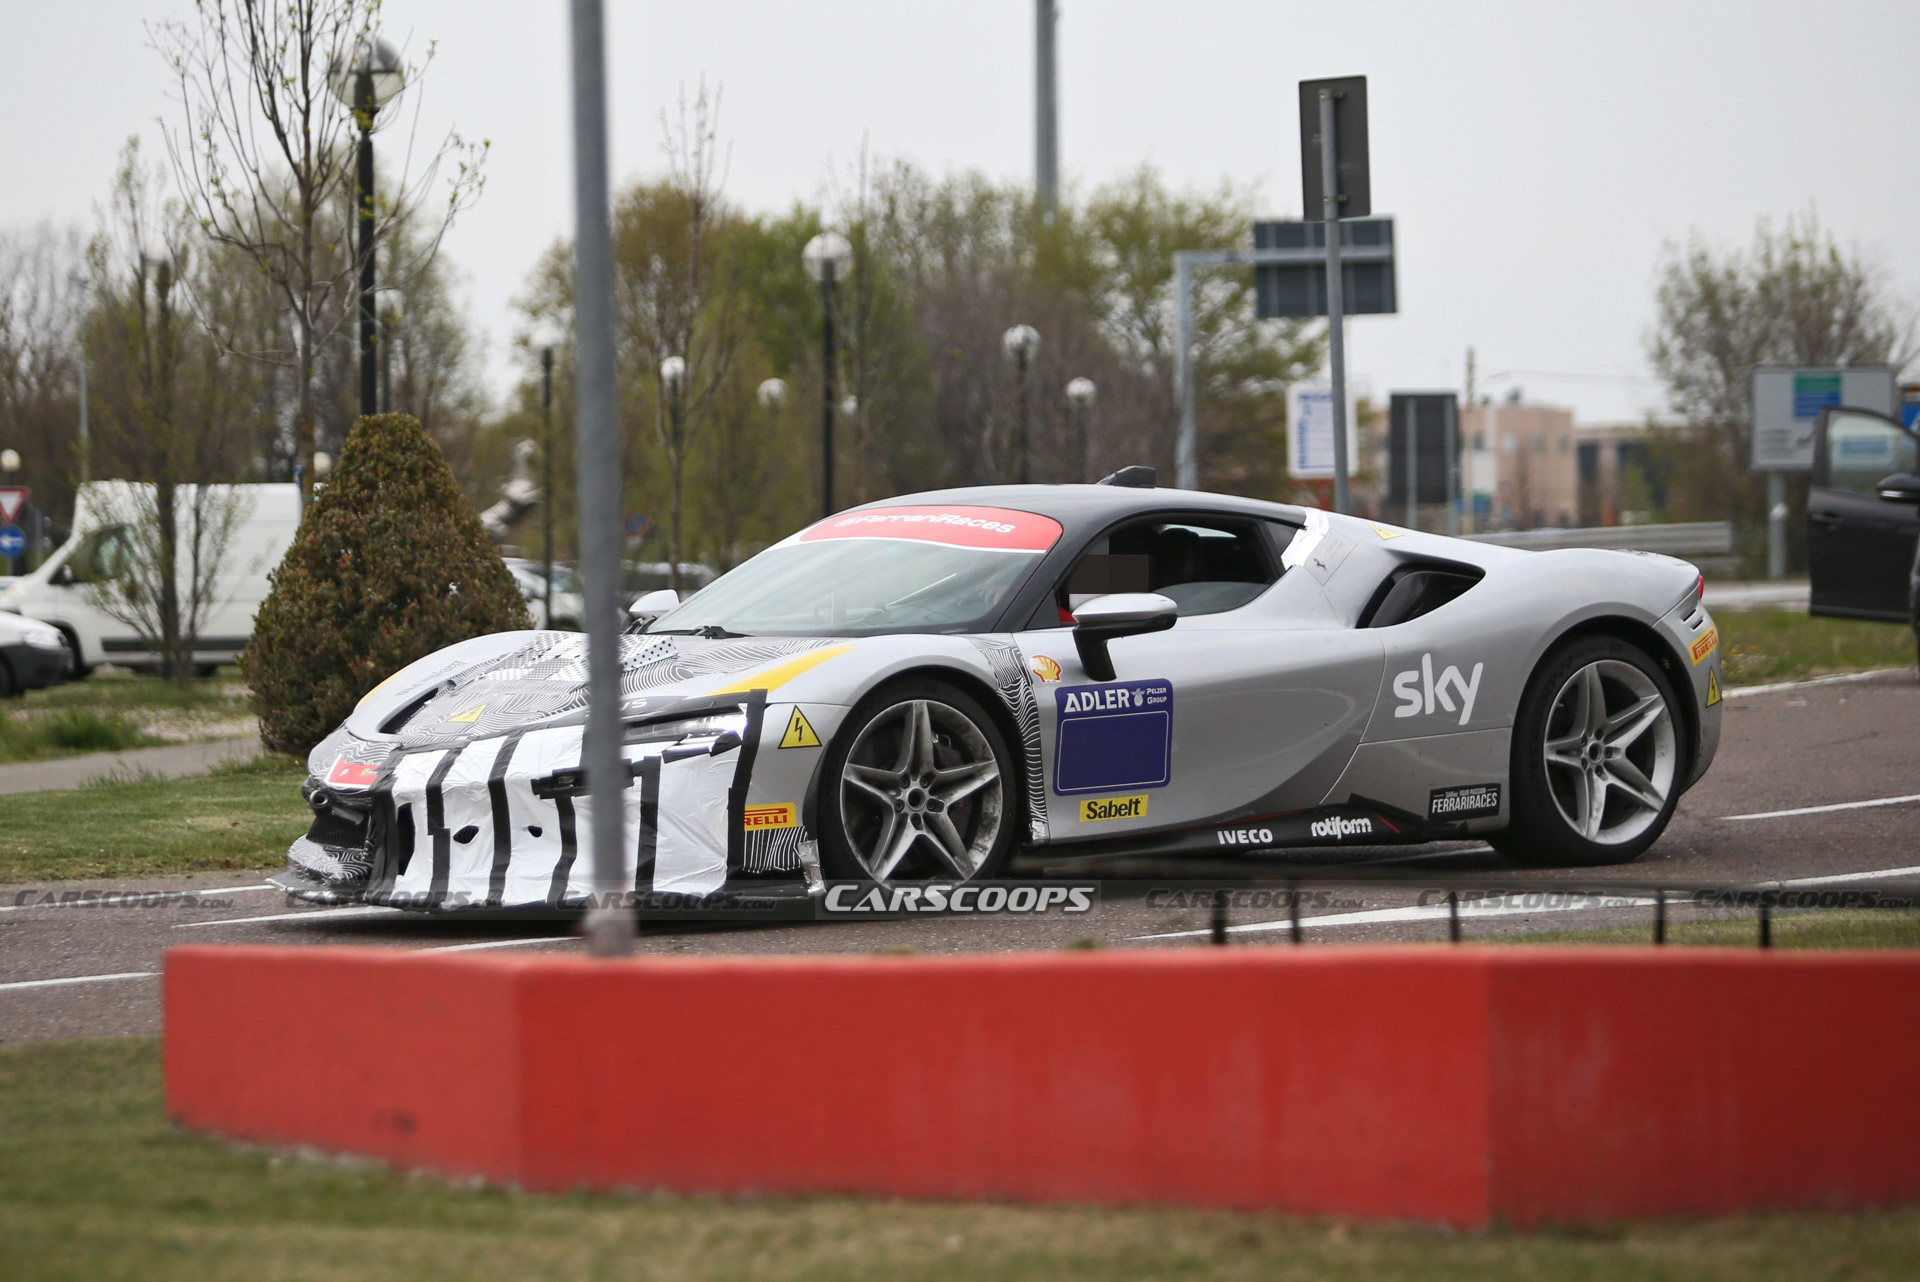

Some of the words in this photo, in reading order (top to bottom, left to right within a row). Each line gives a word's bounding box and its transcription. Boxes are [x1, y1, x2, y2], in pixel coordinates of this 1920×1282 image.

[834, 513, 1015, 533] @FerrariRaces
[1393, 652, 1484, 726] sky
[1063, 687, 1131, 713] ADLER
[1147, 696, 1168, 704] GROUP
[1086, 798, 1141, 819] Sabelt
[1431, 792, 1498, 813] FERRARIRACES
[1217, 828, 1273, 845] IVECO
[1311, 816, 1373, 839] rotiform
